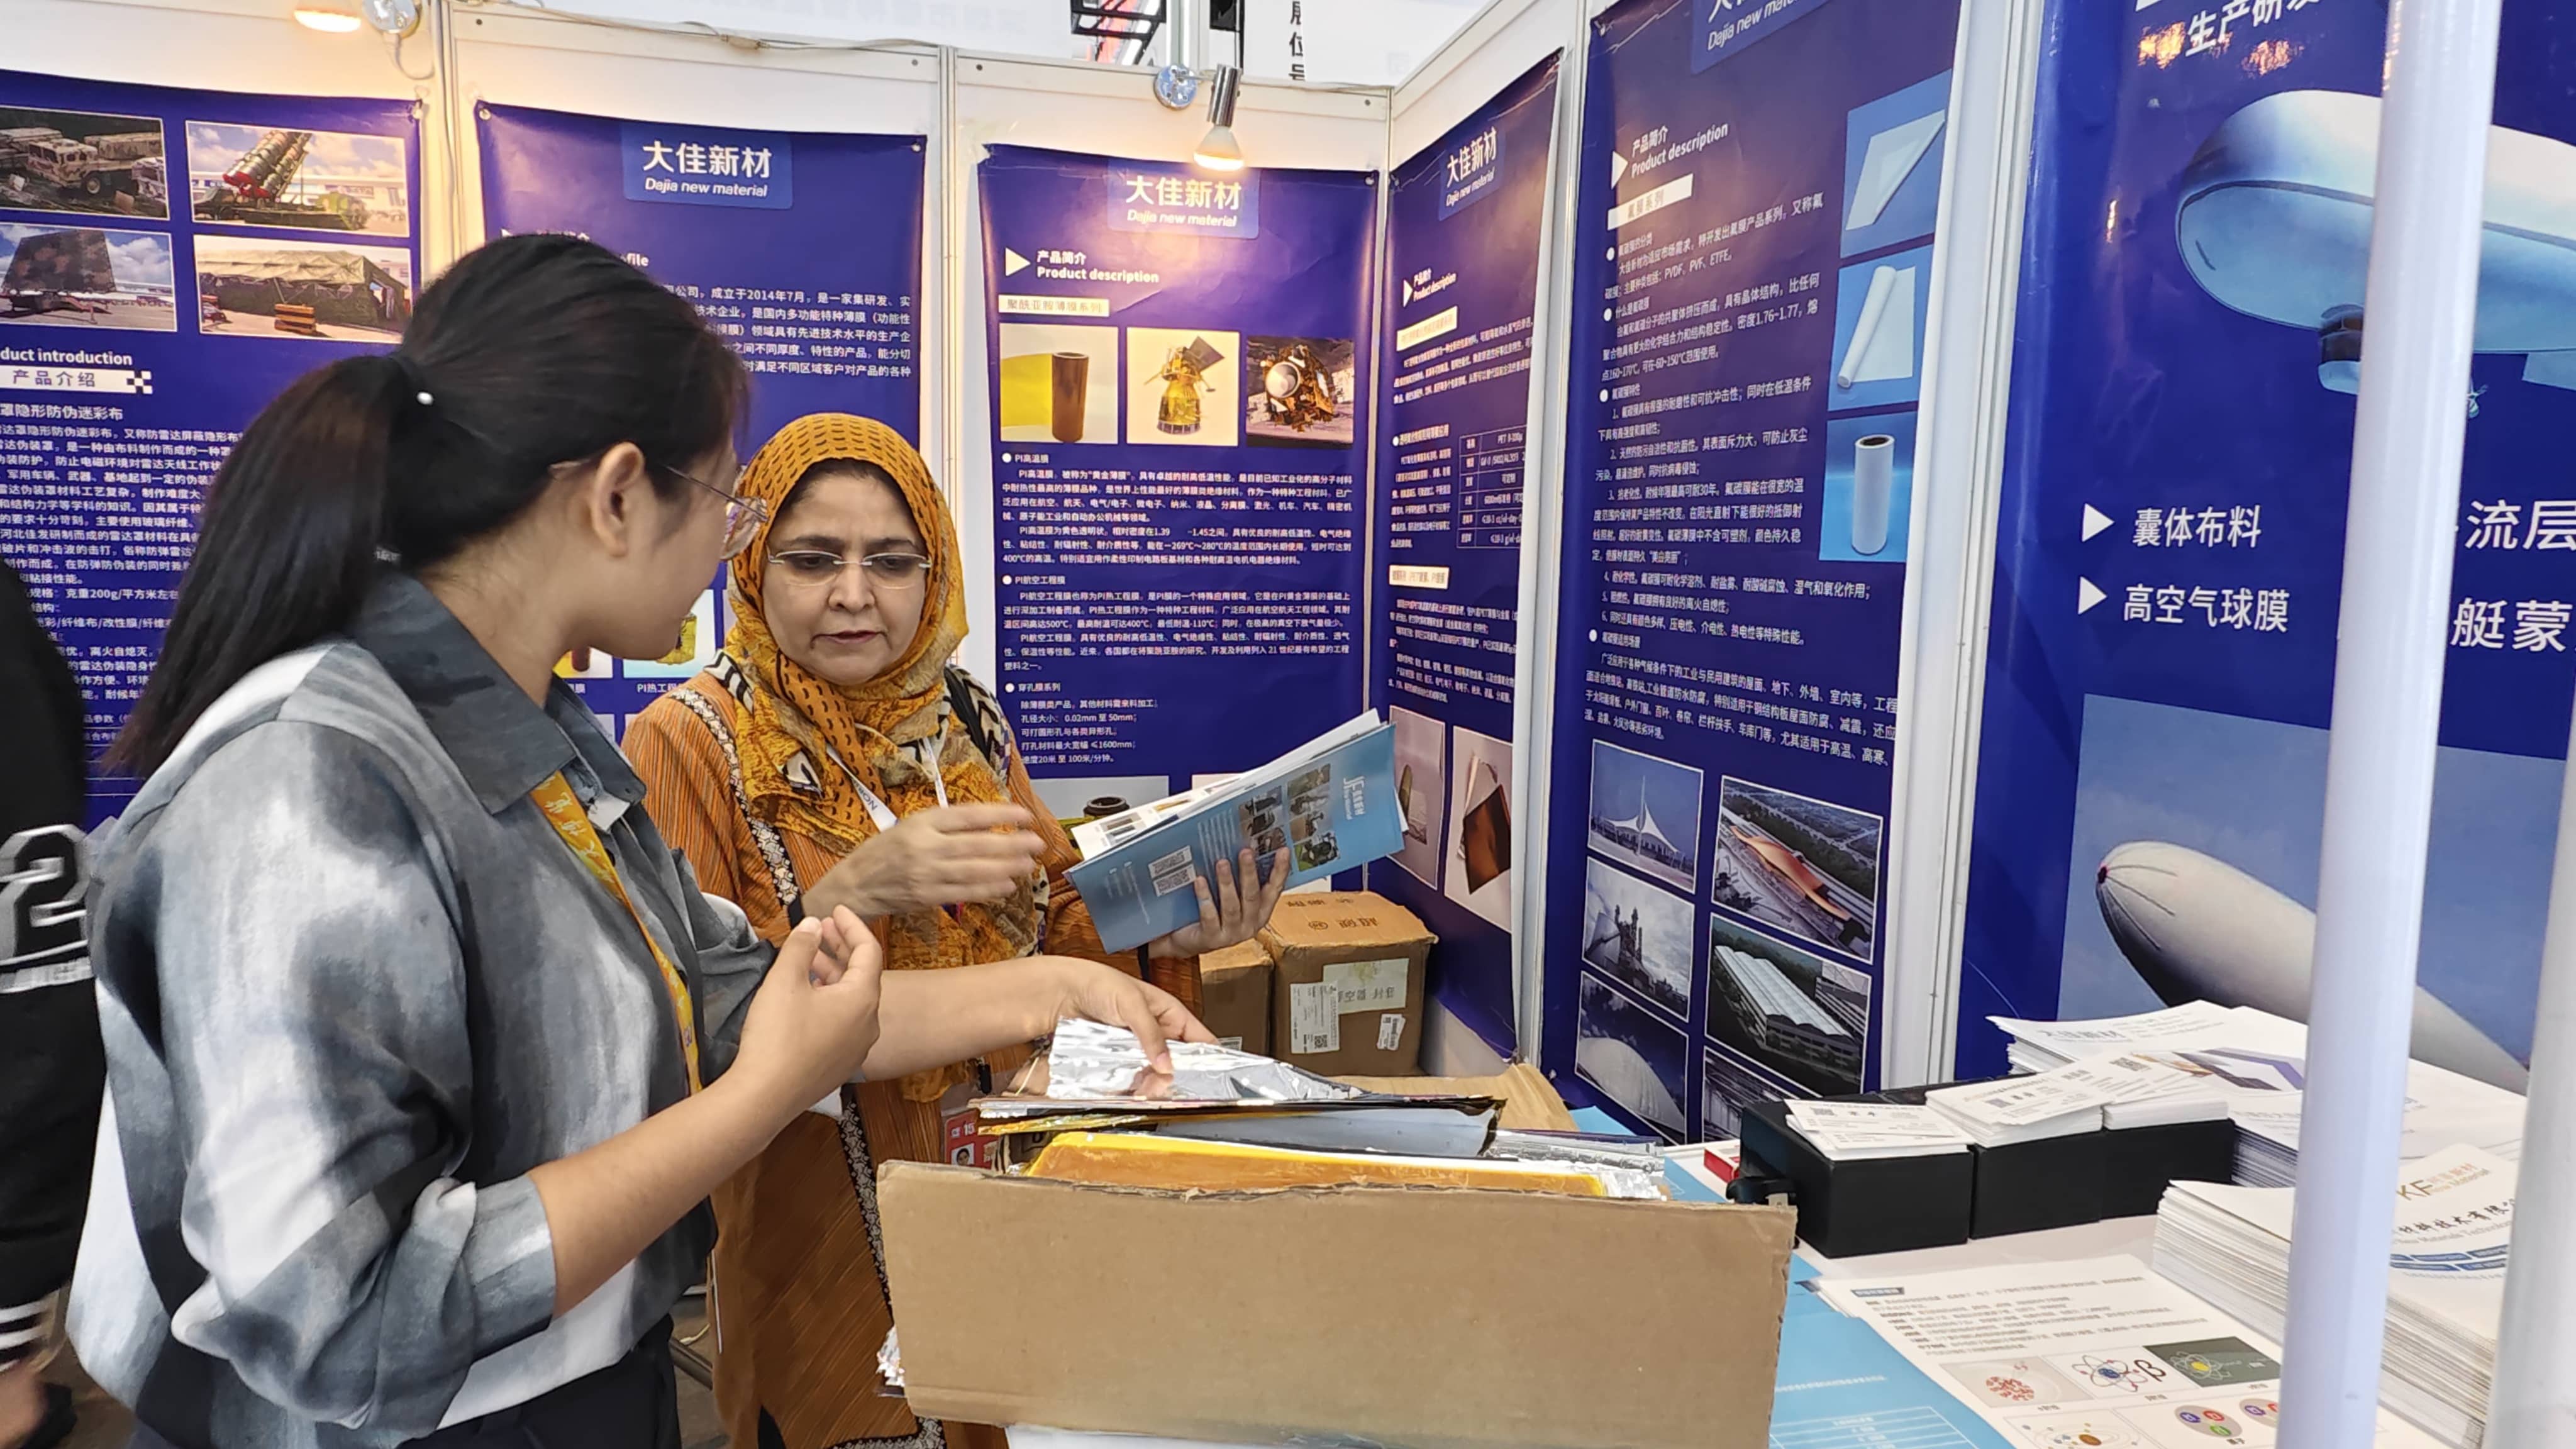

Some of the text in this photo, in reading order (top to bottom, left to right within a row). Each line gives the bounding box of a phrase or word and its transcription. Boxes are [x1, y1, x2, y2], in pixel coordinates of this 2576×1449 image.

[1707, 22, 1734, 50] Dajia
[1736, 8, 1762, 34] new
[1763, 0, 1797, 18] mat
[2185, 0, 2323, 57] 生产研
[1631, 125, 1668, 158] 产品简介
[1631, 123, 1729, 178] Product description
[643, 140, 772, 179] 大佳新材
[1446, 125, 1496, 187] 大佳新材
[645, 177, 768, 197] Dajia new material
[1126, 175, 1241, 210] 大佳新材
[1127, 209, 1237, 228] Dajia new material
[621, 253, 649, 267] file
[1037, 250, 1087, 265] 产品简介
[1037, 266, 1160, 284] Product description
[38, 349, 133, 365] introduction
[12, 369, 96, 387] 产品介绍
[0, 403, 124, 421] 罩隐形防伪迷彩布
[0, 440, 231, 457] 达伪装罩，是一种由布料制作而成的一种罩
[2131, 504, 2262, 548] 囊体布料
[2456, 499, 2576, 552] 流层
[0, 544, 196, 558] 破片和冲击波的击打，俗称防弹雷达
[2123, 583, 2290, 633] 高空气球膜
[37, 617, 172, 630] 彩/纤维布/改性膜/纤维
[2450, 597, 2576, 652] 艇蒙
[81, 689, 144, 700] 能，耐候年
